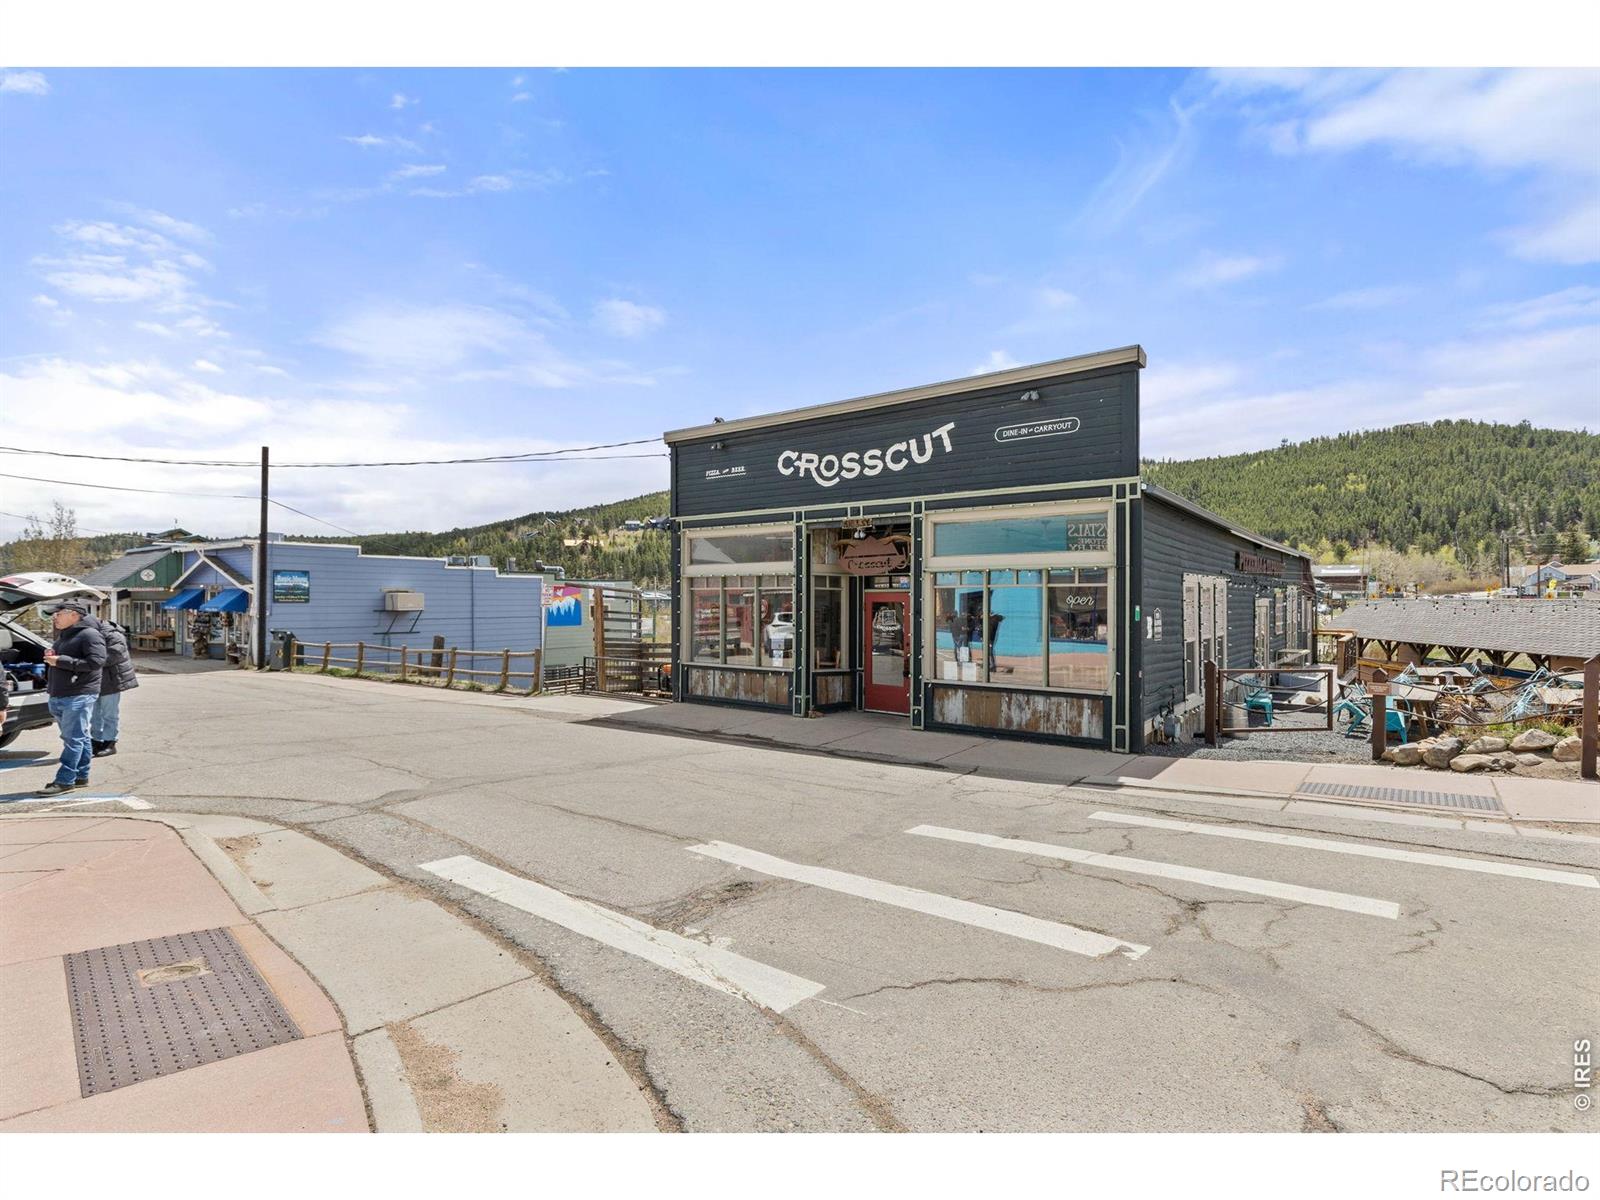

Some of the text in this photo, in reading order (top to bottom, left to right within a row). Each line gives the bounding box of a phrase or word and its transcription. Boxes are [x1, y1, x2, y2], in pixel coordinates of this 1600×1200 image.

[1002, 427, 1028, 438] DINE-IN
[1034, 421, 1073, 433] CARRYOUT
[777, 421, 955, 487] CROSSCUT
[1065, 594, 1095, 609] open
